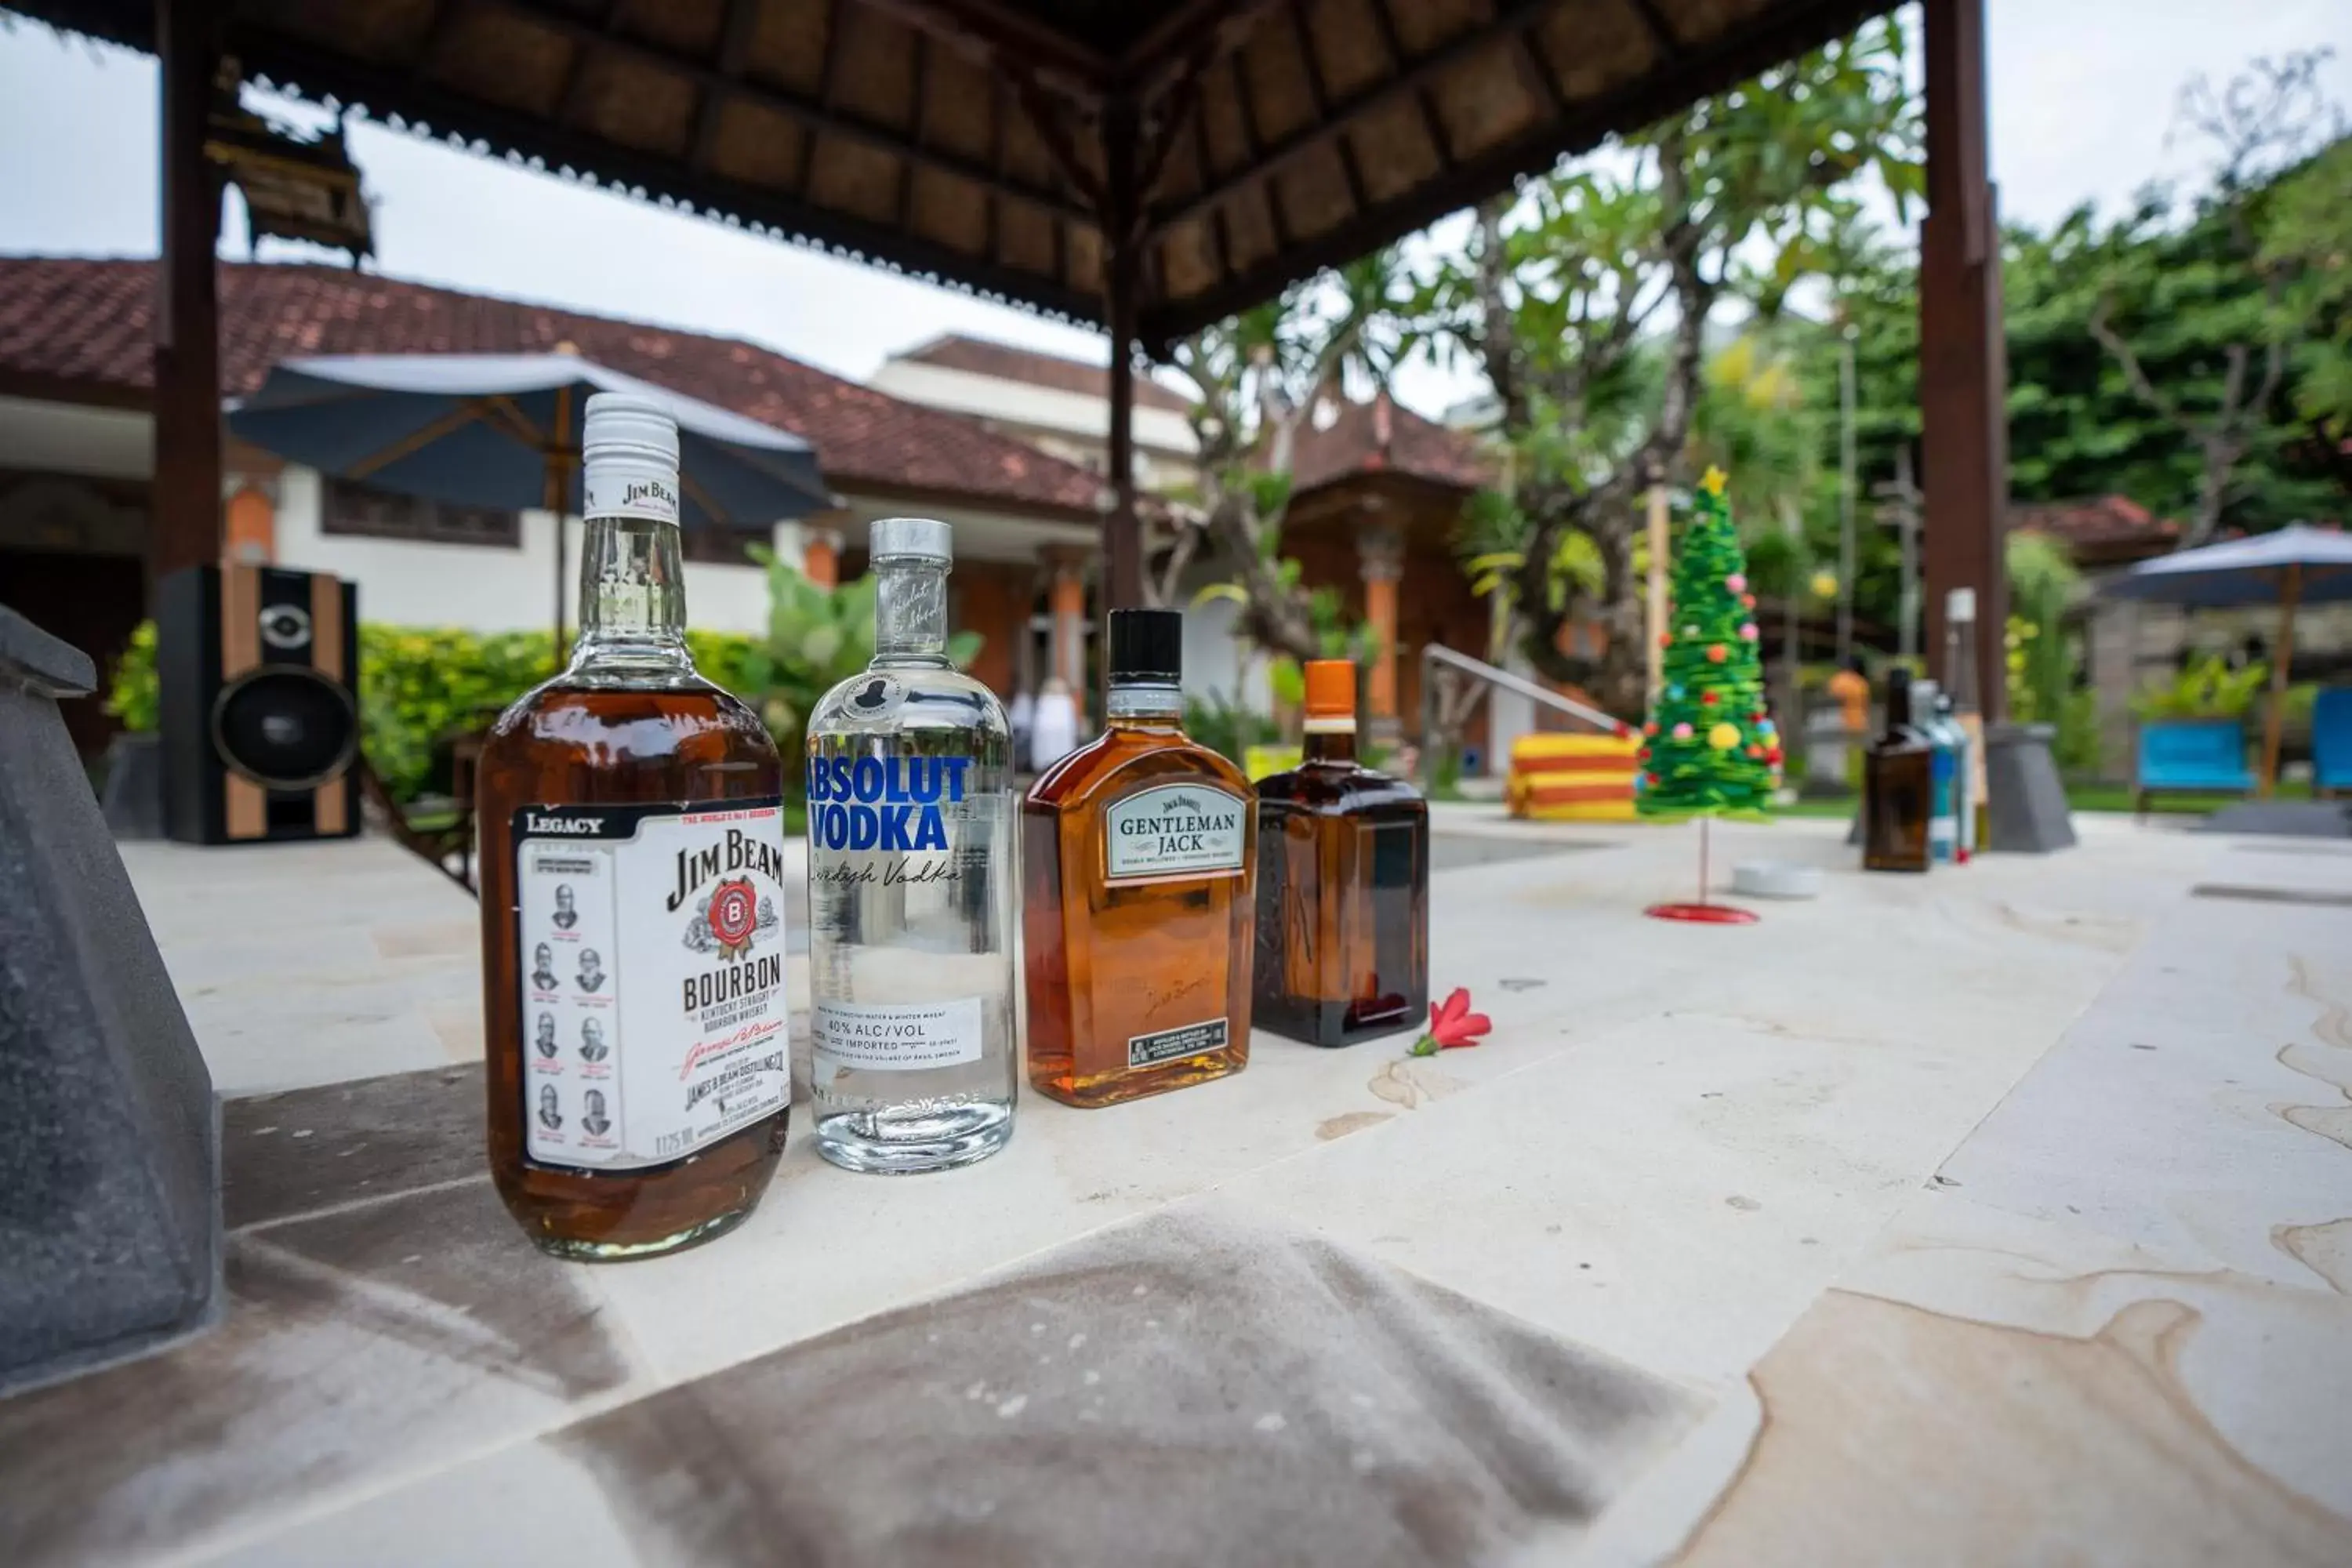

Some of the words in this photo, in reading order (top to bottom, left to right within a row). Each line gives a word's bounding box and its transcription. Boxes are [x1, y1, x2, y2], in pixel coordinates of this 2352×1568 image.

[622, 484, 648, 505] JIM
[526, 812, 605, 833] LEGACY
[811, 803, 949, 851] VODKA
[1120, 814, 1235, 835] GENTLEMAN
[1158, 834, 1203, 855] JACK
[667, 842, 720, 913] JIM
[726, 829, 783, 890] BEAM
[883, 855, 962, 886] Vodka
[728, 902, 741, 923] B
[684, 953, 780, 1011] BOURBON
[847, 1039, 898, 1050] IMPORTED
